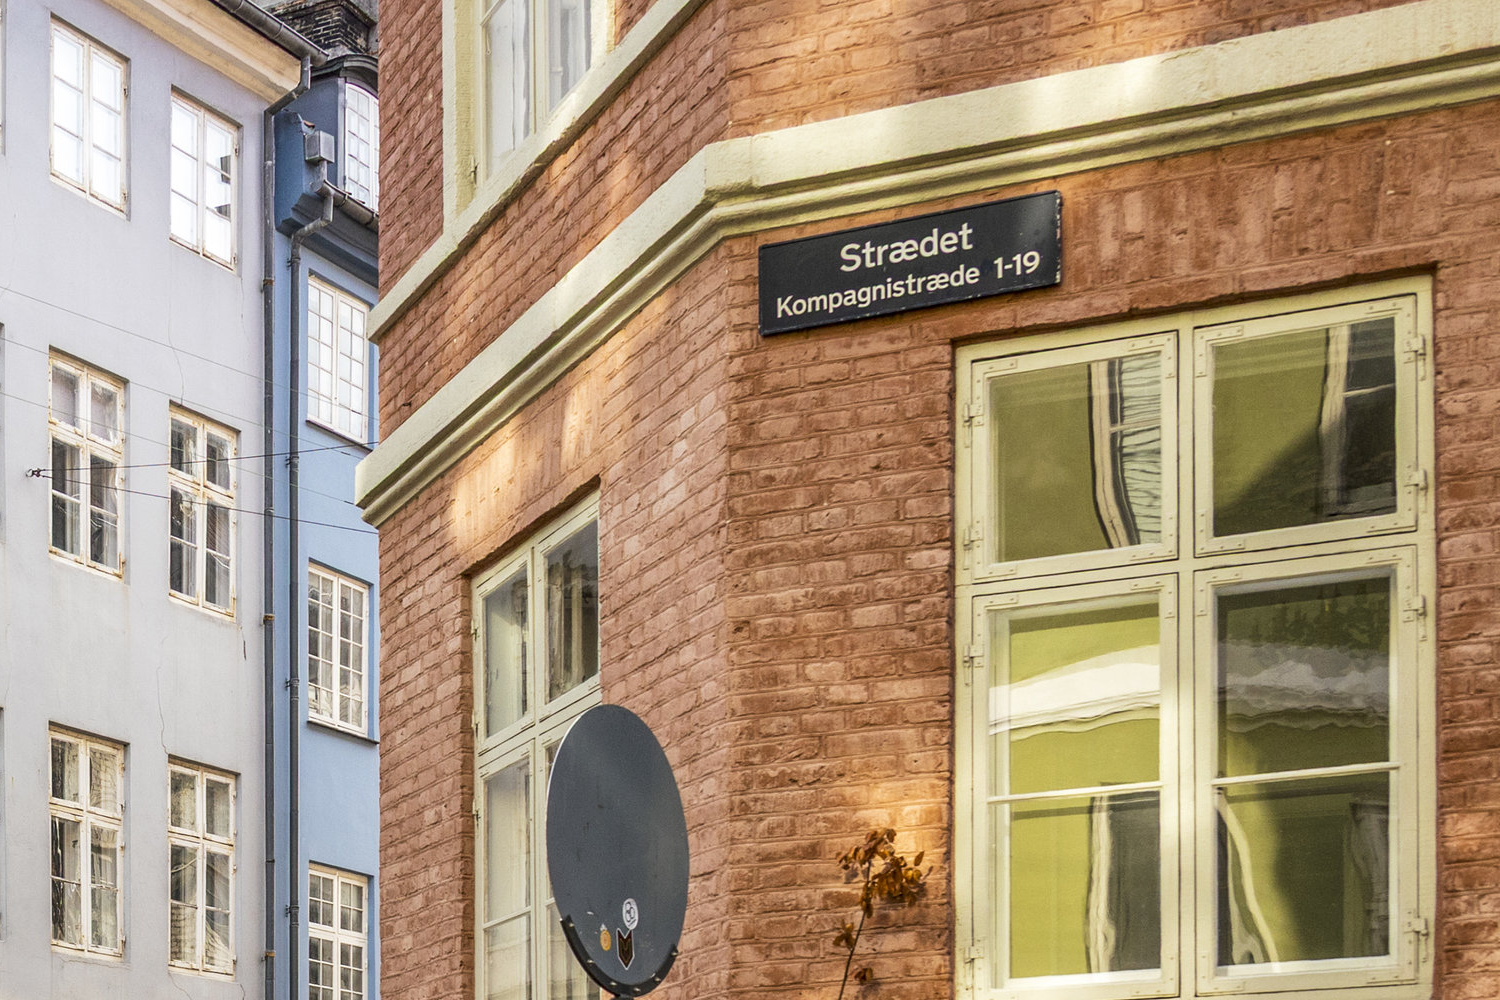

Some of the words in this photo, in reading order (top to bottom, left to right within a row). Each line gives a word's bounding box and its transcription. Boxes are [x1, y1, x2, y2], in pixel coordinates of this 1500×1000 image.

[839, 221, 973, 272] Strædet
[776, 263, 980, 319] Kompagnistræde
[992, 250, 1041, 279] 1-19
